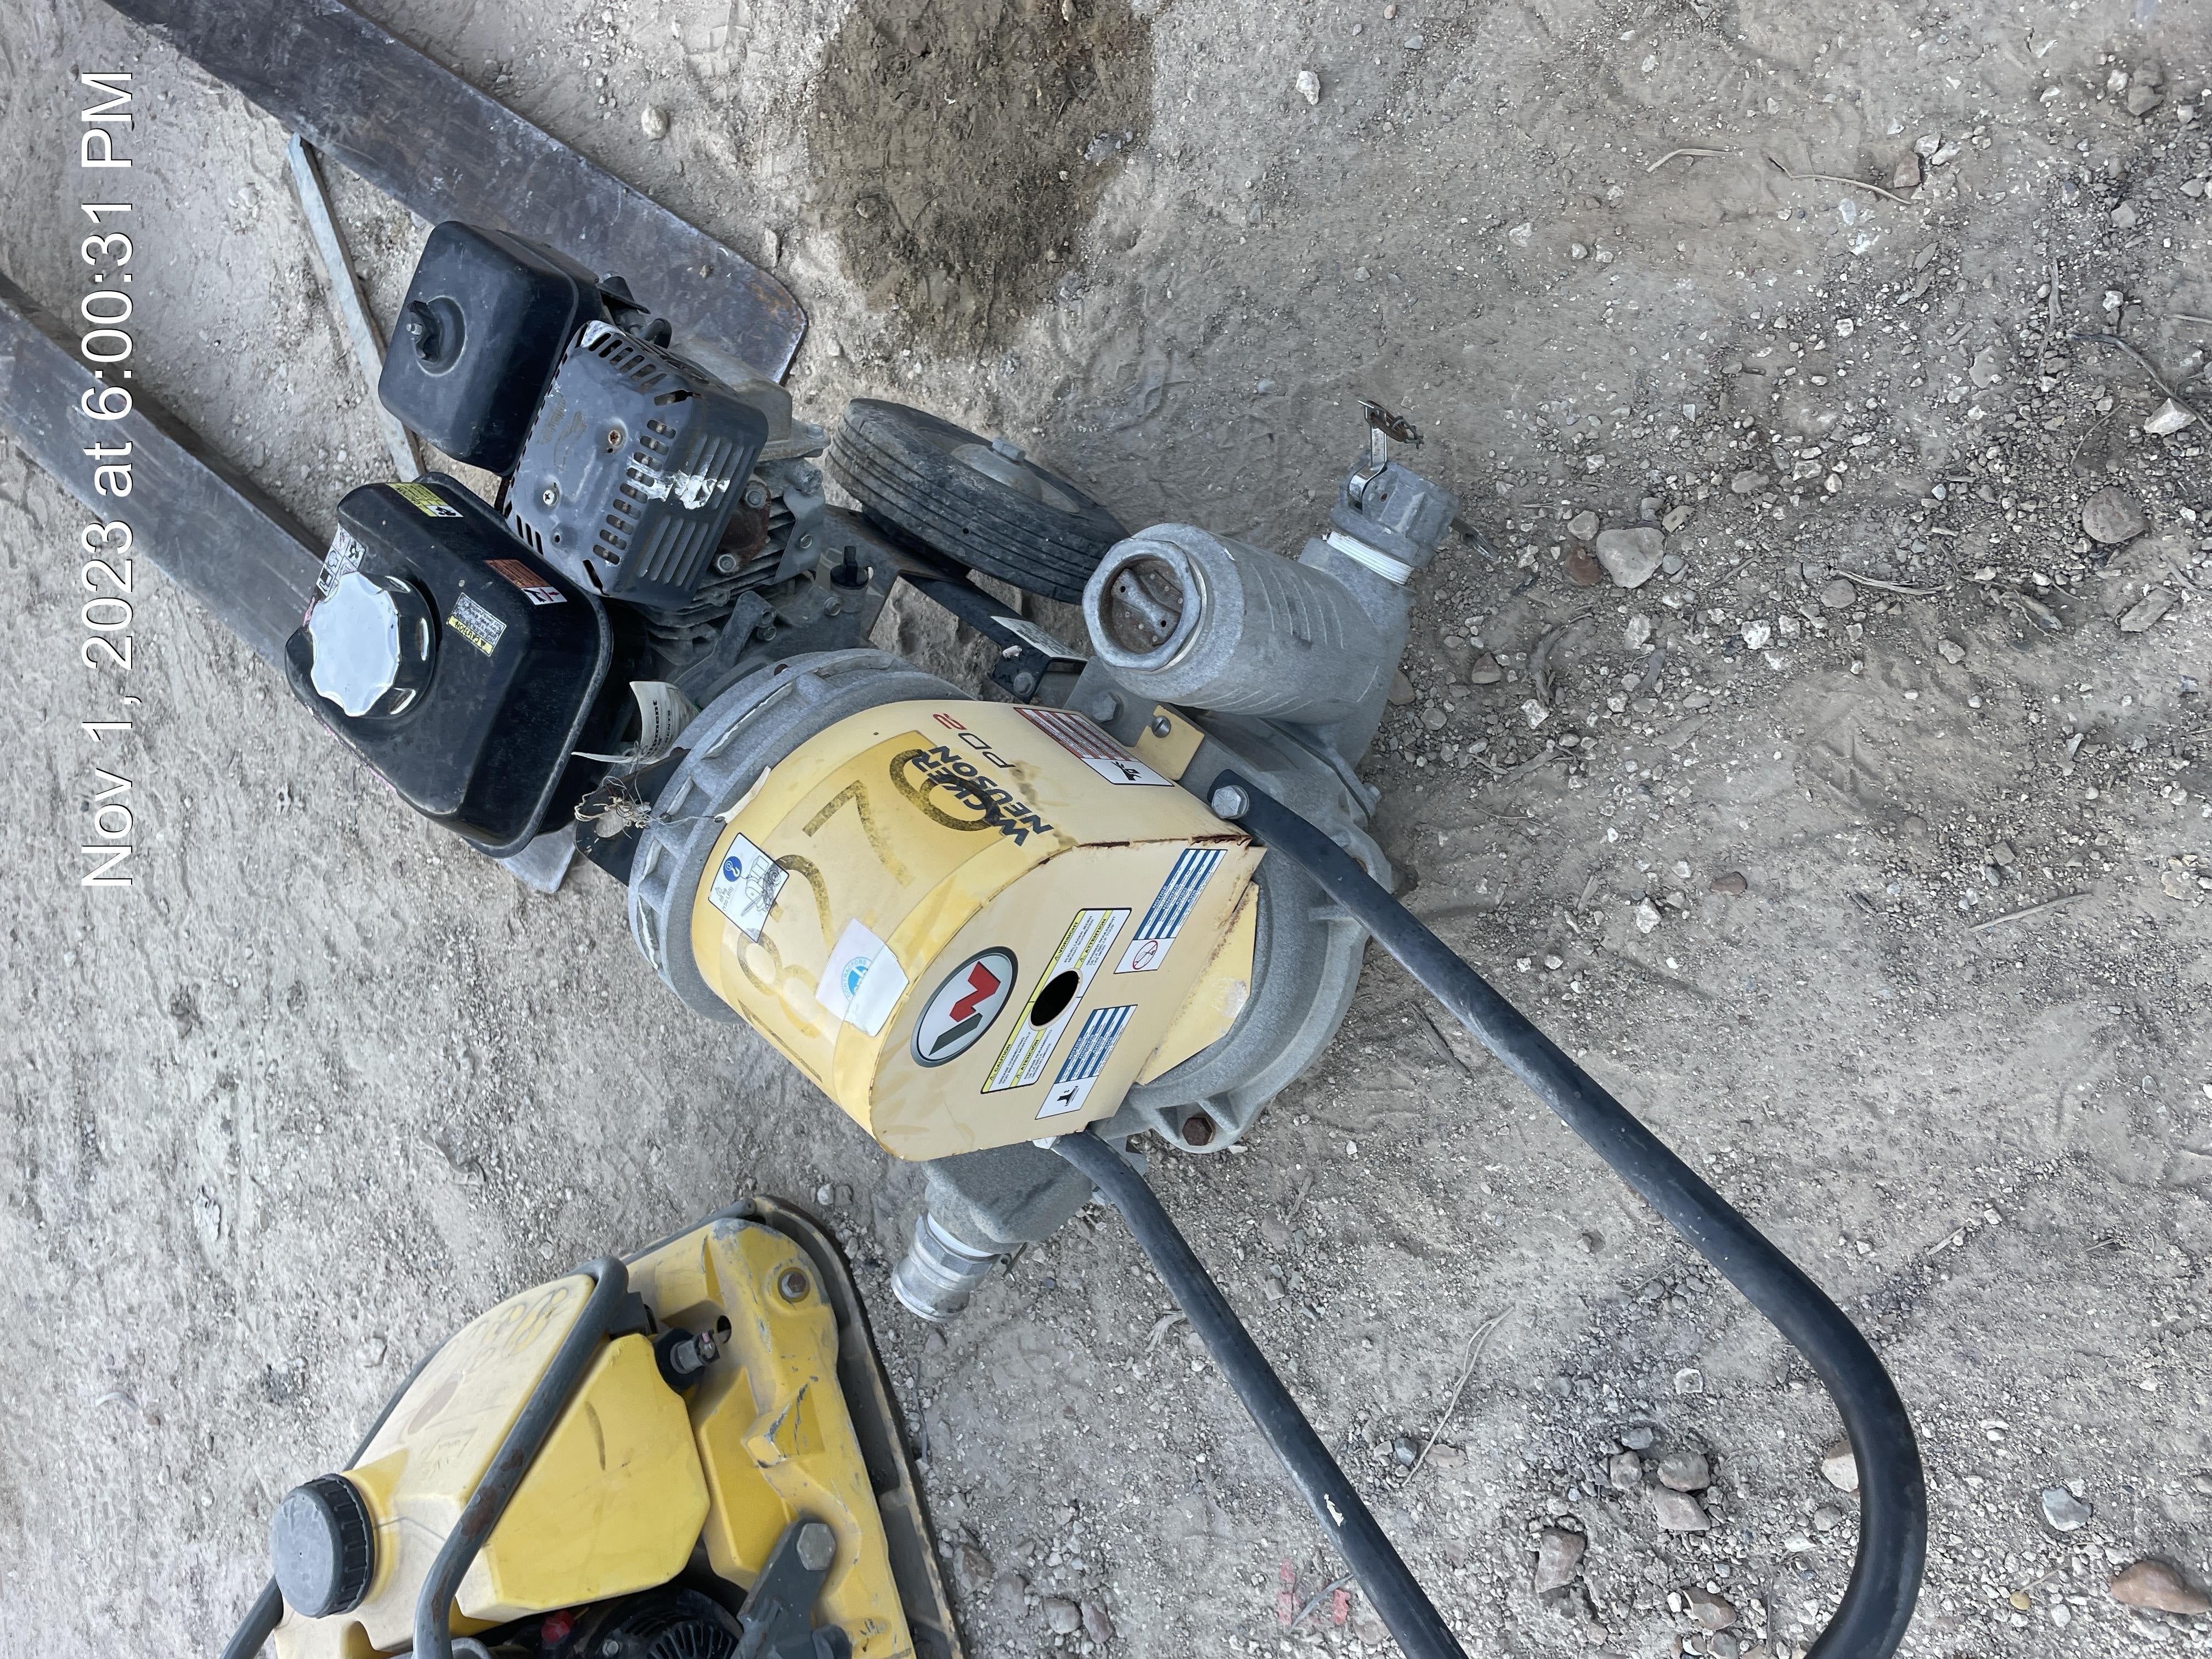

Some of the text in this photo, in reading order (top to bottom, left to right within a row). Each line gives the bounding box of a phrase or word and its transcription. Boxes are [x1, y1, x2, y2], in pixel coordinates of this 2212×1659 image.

[454, 620, 480, 644] CAUTION
[911, 751, 1030, 847] WACKER
[927, 746, 1054, 834] NEUSON
[1058, 921, 1079, 953] VORSICHT
[1084, 918, 1107, 953] ATTENTION
[843, 959, 867, 997] CONTRACTORS
[993, 1043, 1011, 1072] CAUTION
[1018, 1039, 1040, 1070] ATENCIÓN
